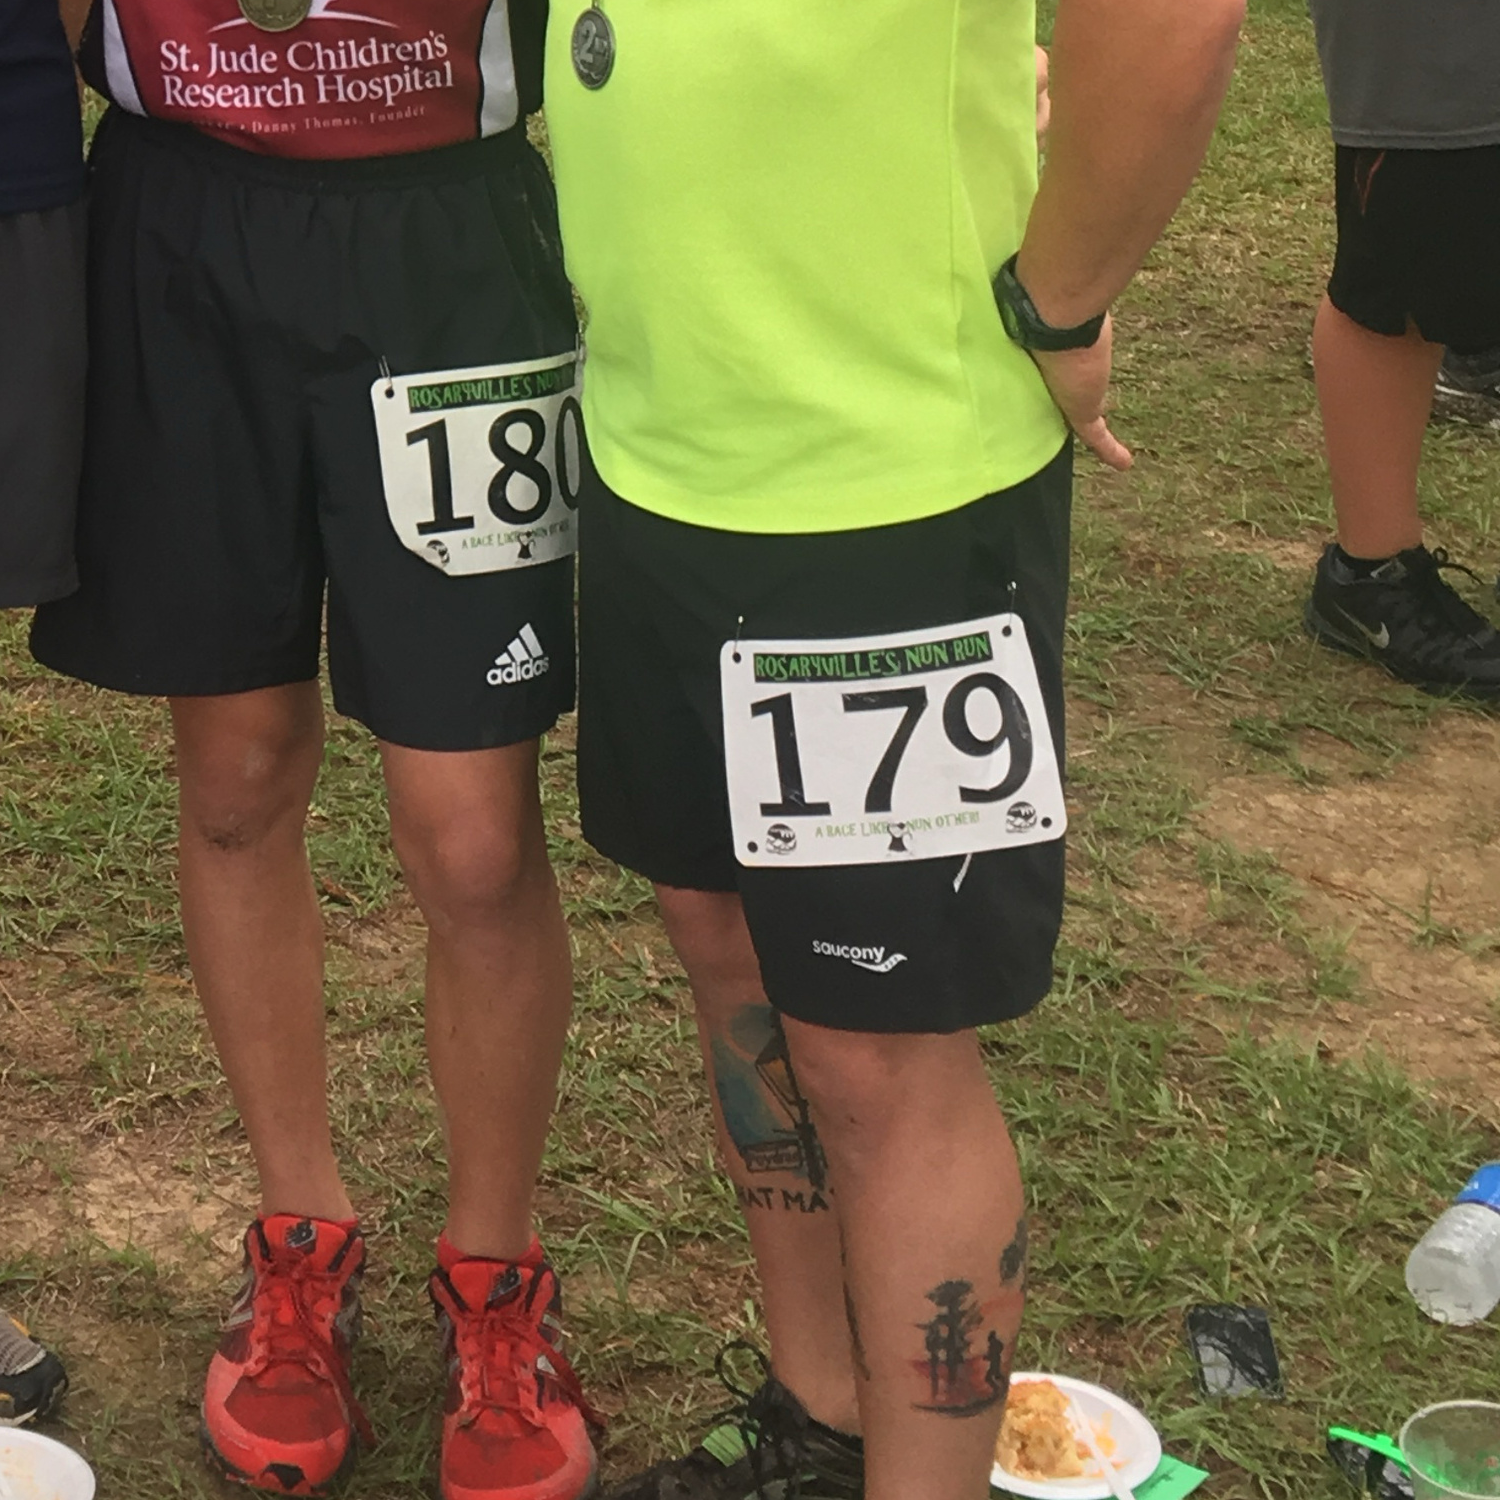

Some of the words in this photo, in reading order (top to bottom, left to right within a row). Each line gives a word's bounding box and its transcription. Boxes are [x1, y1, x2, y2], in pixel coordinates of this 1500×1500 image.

[160, 39, 199, 73] St.
[207, 42, 278, 78] Jude
[287, 30, 448, 73] Children's
[164, 75, 305, 109] Research
[316, 61, 453, 106] Hospital
[410, 375, 533, 410] ROSARYVILLE'S
[406, 395, 583, 536] 180
[486, 656, 550, 686] adidas
[755, 651, 900, 682] ROSARYVILLE'S
[905, 643, 949, 672] NUN
[954, 634, 990, 662] RUN
[750, 672, 1034, 817] 179
[815, 826, 824, 839] A
[826, 823, 857, 838] RACE
[861, 821, 890, 837] LIKE
[904, 817, 932, 833] NUN
[812, 939, 886, 962] saucony
